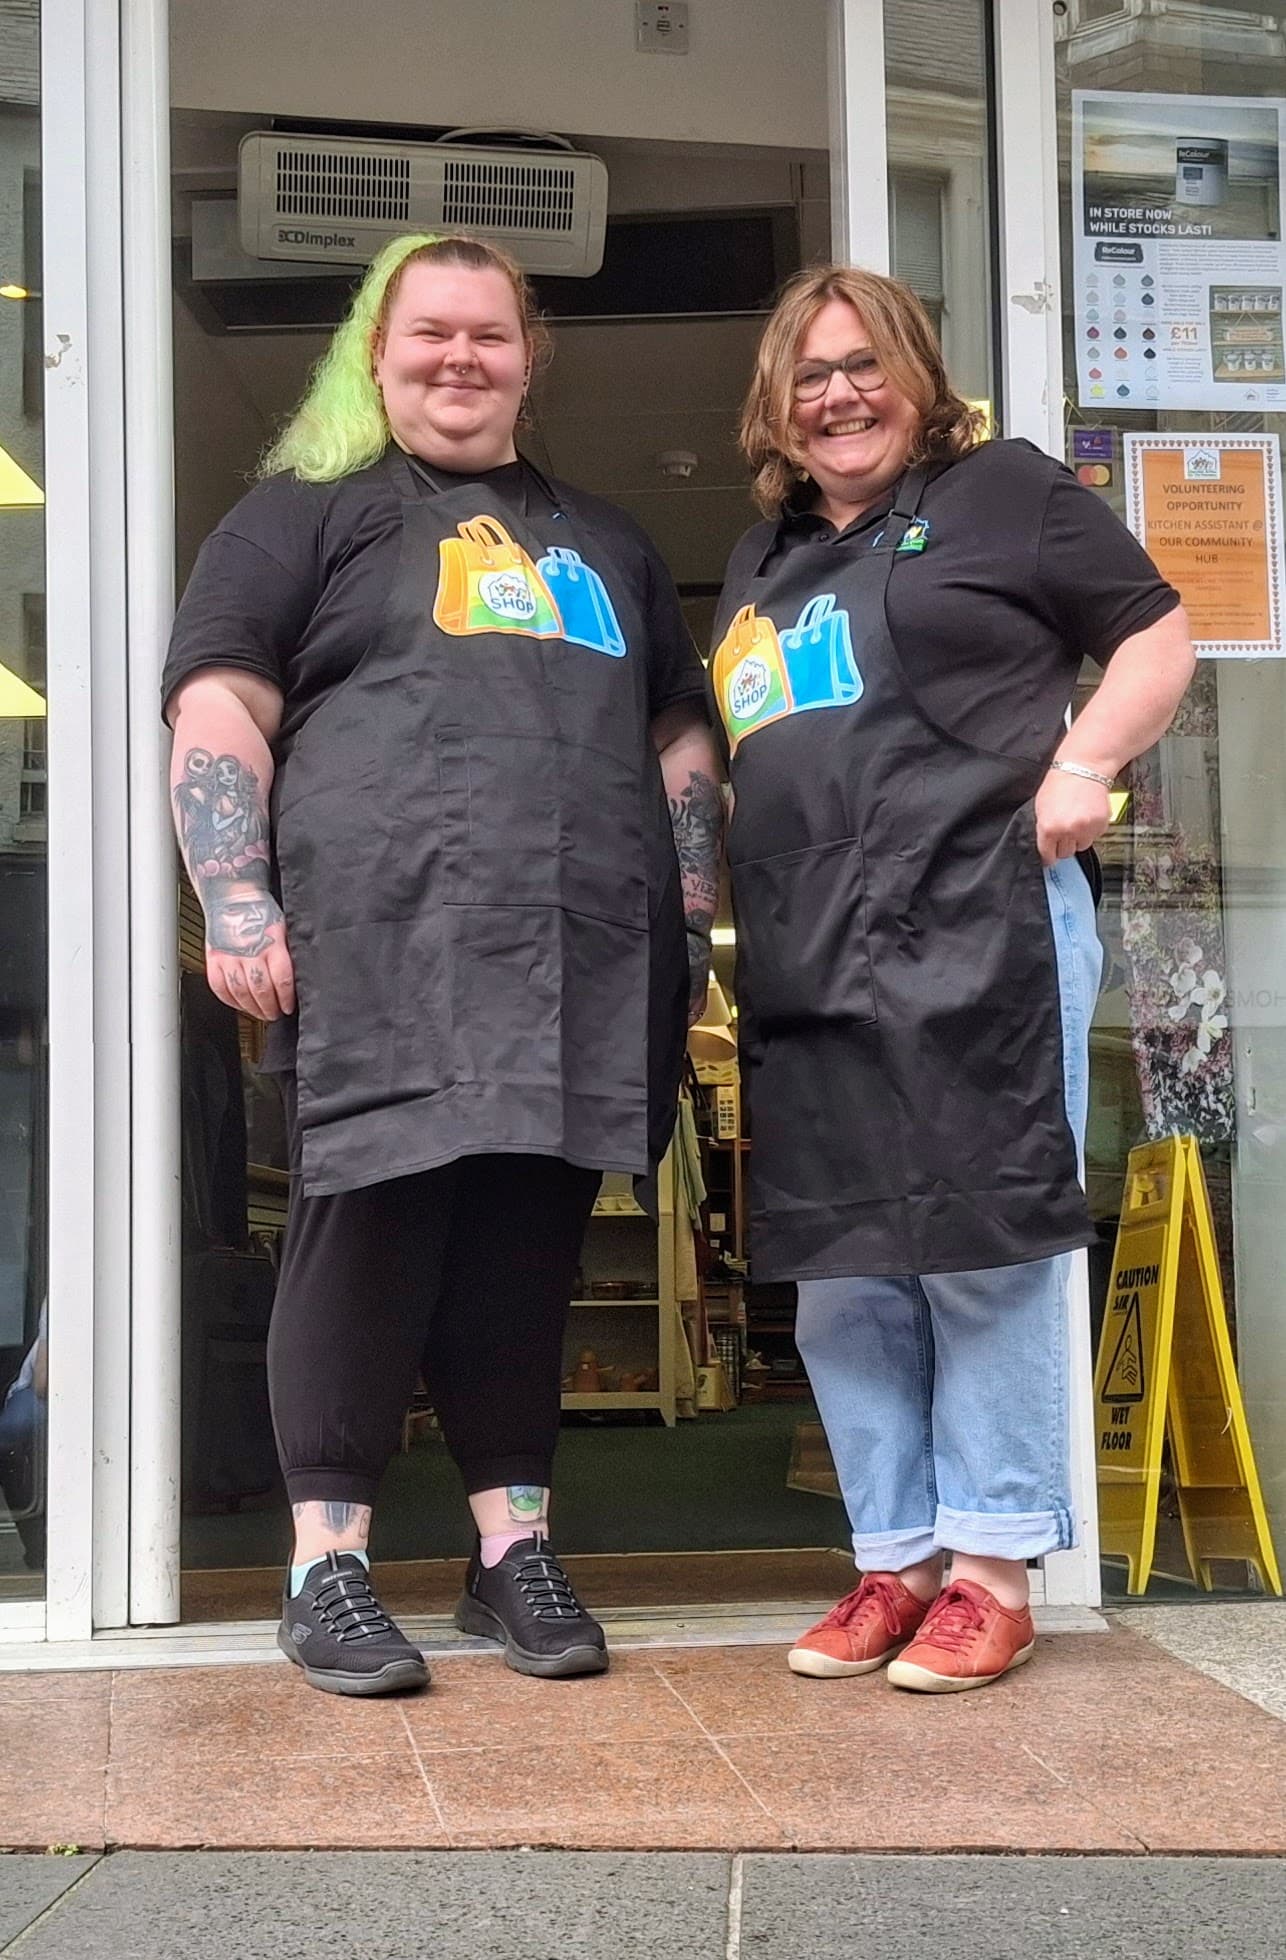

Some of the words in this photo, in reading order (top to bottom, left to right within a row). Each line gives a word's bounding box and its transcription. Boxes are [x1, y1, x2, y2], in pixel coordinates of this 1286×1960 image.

[1089, 207, 1102, 218] IN
[1104, 207, 1143, 219] STORE
[1145, 208, 1172, 220] NOW
[1089, 222, 1128, 234] WHILE
[1129, 223, 1176, 235] STOCKS
[294, 230, 356, 249] Dimplex
[1170, 326, 1198, 341] £11
[1162, 484, 1246, 496] VOLUNTEERING
[1166, 500, 1242, 512] OPPORTUNITY
[1147, 519, 1192, 531] KITCHEN
[1194, 519, 1250, 531] ASSISTANT
[1252, 519, 1264, 532] @
[1159, 536, 1183, 547] OUR
[1184, 536, 1254, 548] COMMUNITY
[1195, 554, 1219, 564] HUB
[490, 597, 535, 614] SHOP
[733, 684, 767, 714] SHOP
[1116, 1264, 1159, 1290] CAUTION
[1111, 1406, 1130, 1424] WET
[1101, 1431, 1132, 1449] FLOOR
